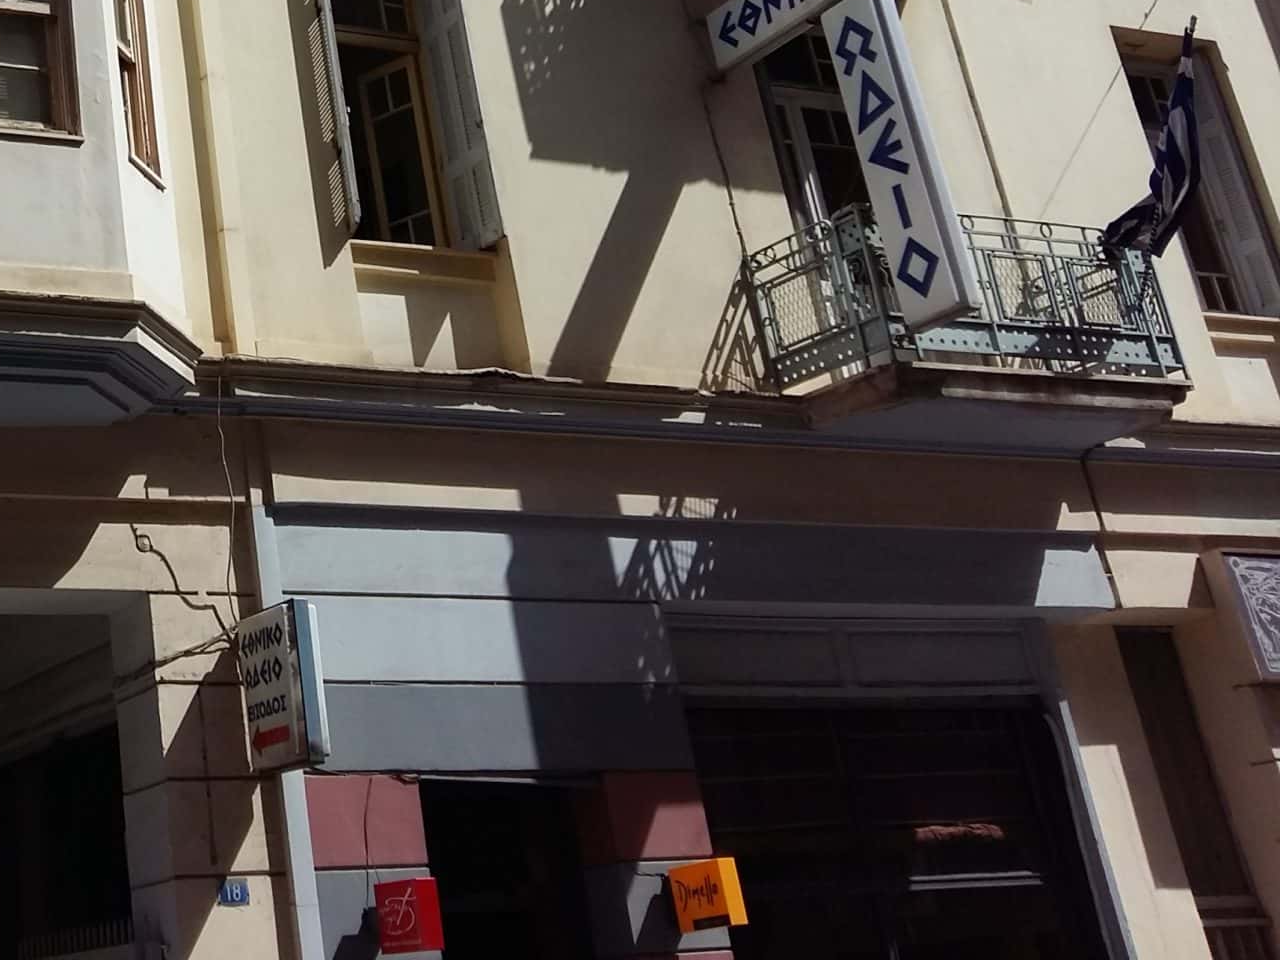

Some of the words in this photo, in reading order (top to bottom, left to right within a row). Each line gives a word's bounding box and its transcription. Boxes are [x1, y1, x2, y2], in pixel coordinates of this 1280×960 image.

[835, 15, 940, 299] ΩΔΕΙΟ
[241, 622, 283, 658] ΕΘΝΙΚΟ
[245, 656, 282, 690] ΩΔΕΙΟ
[226, 882, 241, 901] 18
